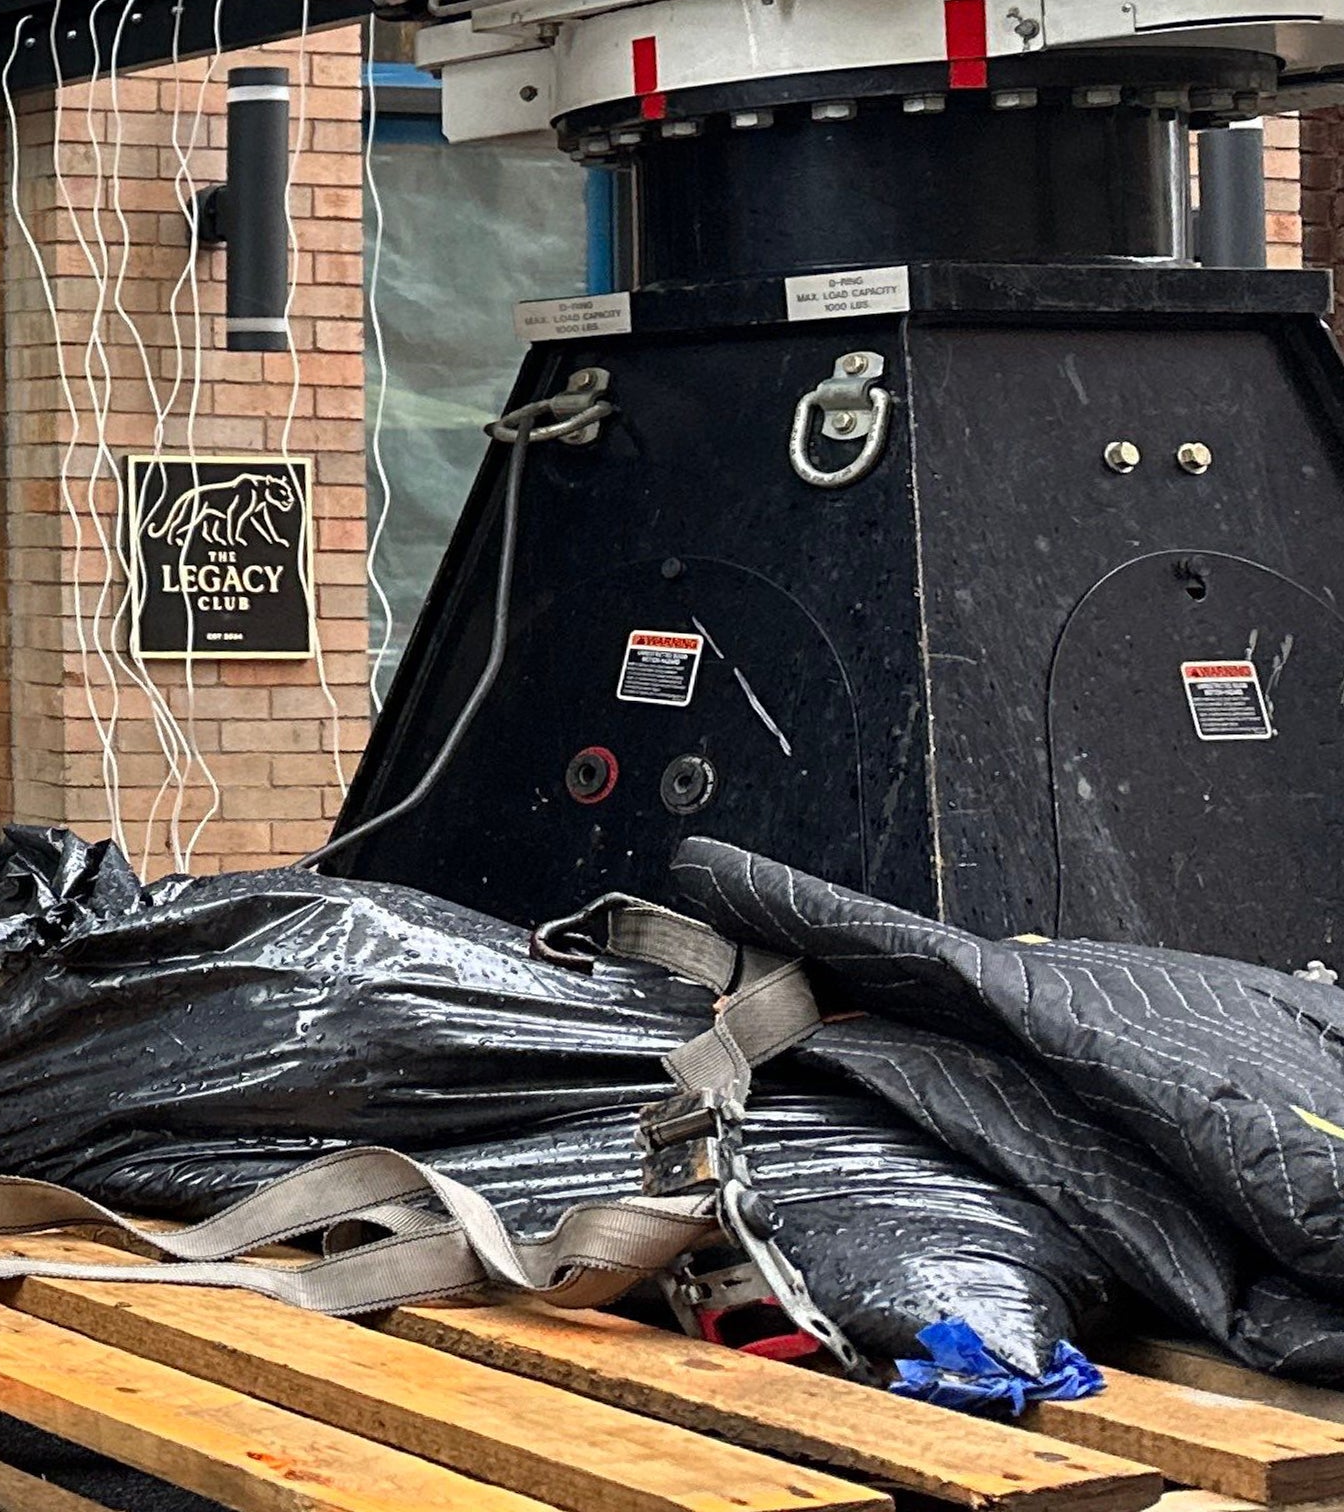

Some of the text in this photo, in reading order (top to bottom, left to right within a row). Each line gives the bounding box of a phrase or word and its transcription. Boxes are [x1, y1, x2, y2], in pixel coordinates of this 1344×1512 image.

[828, 276, 863, 288] D-RING
[822, 291, 848, 300] LOAD
[852, 286, 897, 297] CAPACITY
[824, 302, 847, 311] 1000
[553, 314, 580, 323] LOAD
[582, 309, 622, 320] CAPACITY
[208, 551, 237, 563] THE
[162, 565, 284, 593] LEGACY
[198, 596, 250, 611] CLUB
[647, 636, 697, 650] WARNING
